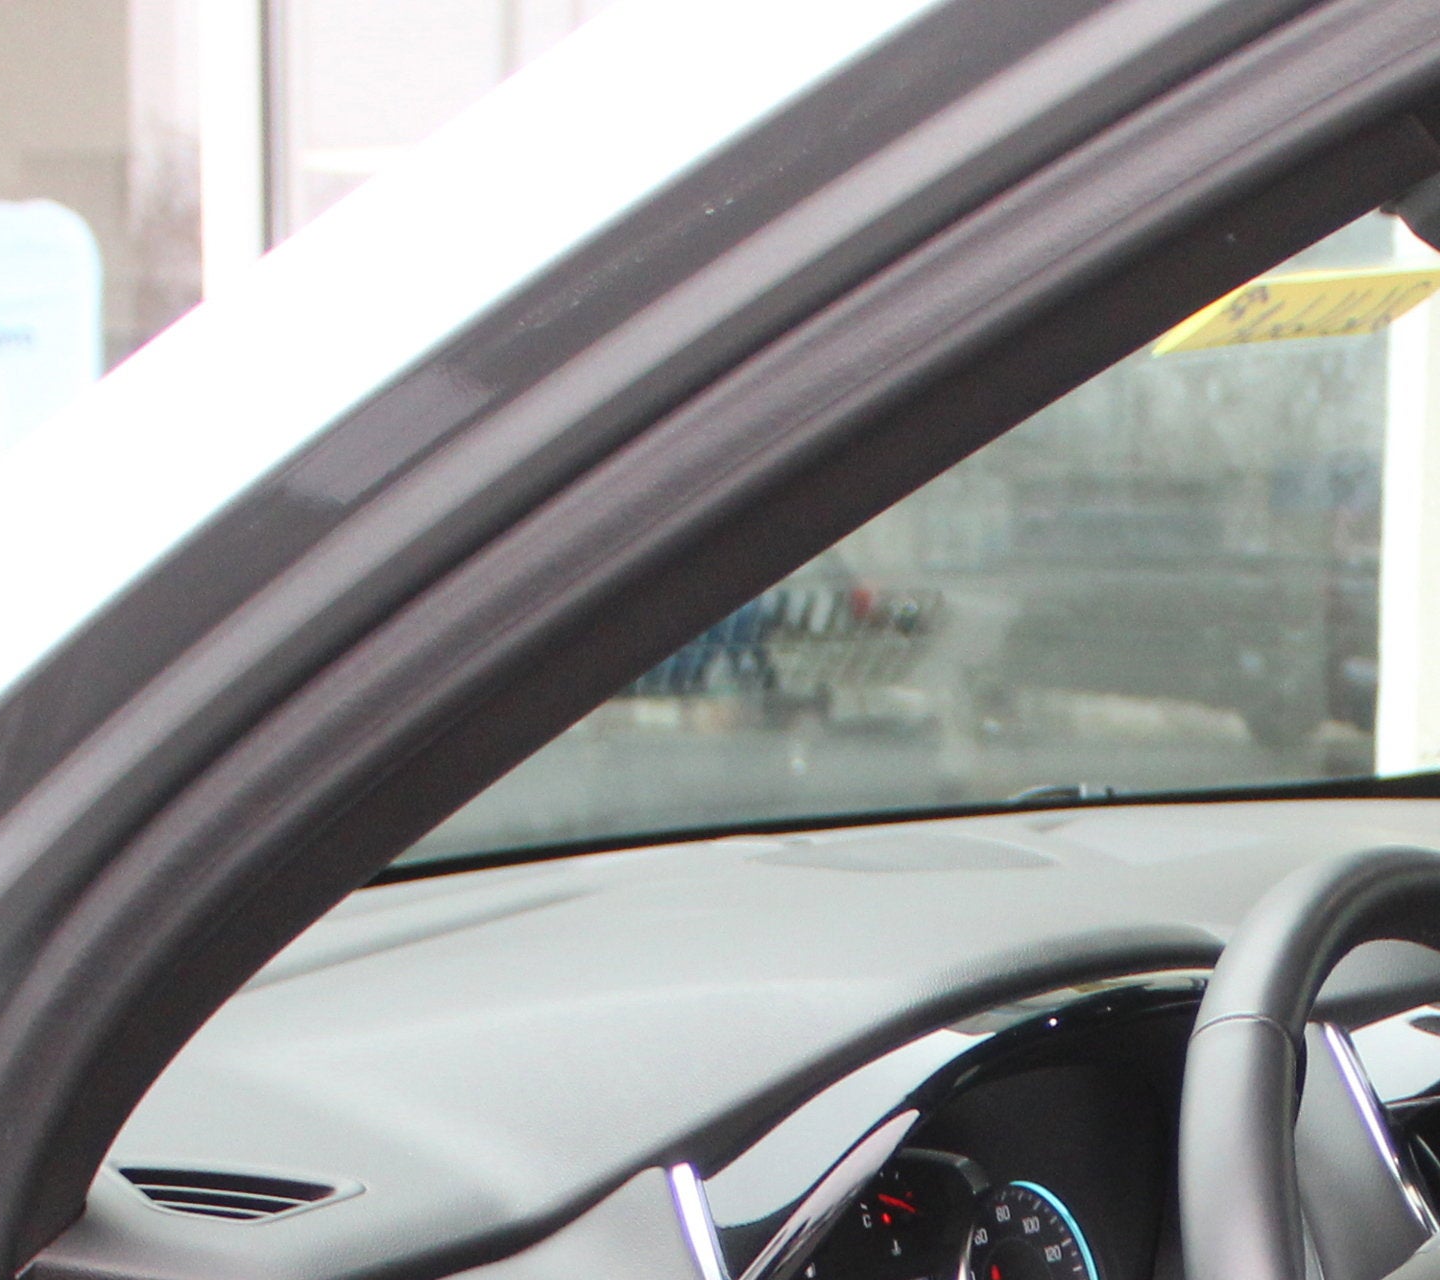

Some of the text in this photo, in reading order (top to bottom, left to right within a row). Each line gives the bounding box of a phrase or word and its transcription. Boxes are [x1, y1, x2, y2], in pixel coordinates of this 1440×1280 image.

[996, 1205, 1010, 1222] 80
[1022, 1216, 1040, 1234] 100
[1044, 1244, 1061, 1262] 120
